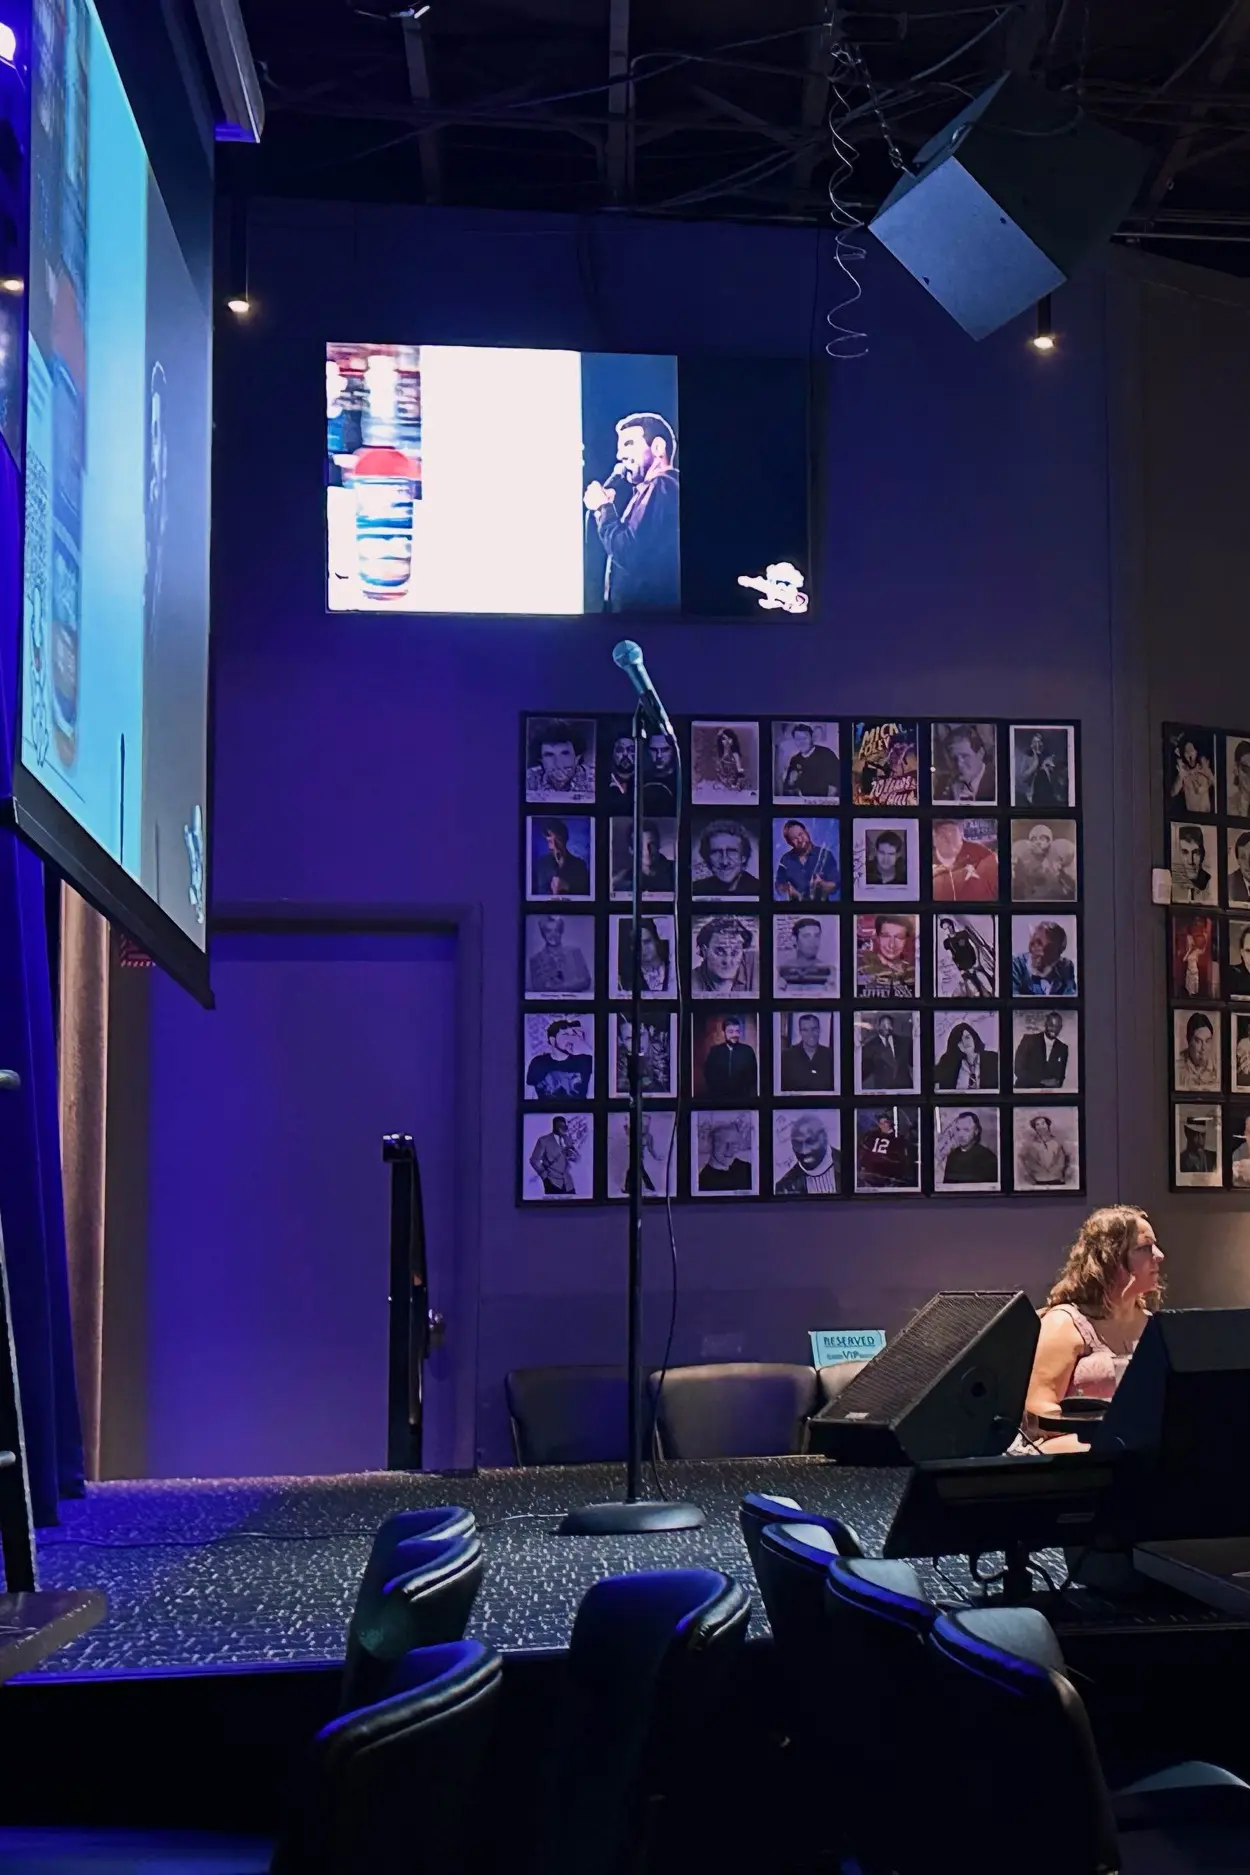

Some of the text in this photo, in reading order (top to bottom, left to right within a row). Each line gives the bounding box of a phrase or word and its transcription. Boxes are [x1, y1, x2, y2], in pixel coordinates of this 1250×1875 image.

[871, 1137, 891, 1155] 12
[823, 1336, 875, 1346] RESERVED
[842, 1350, 860, 1359] VIP
